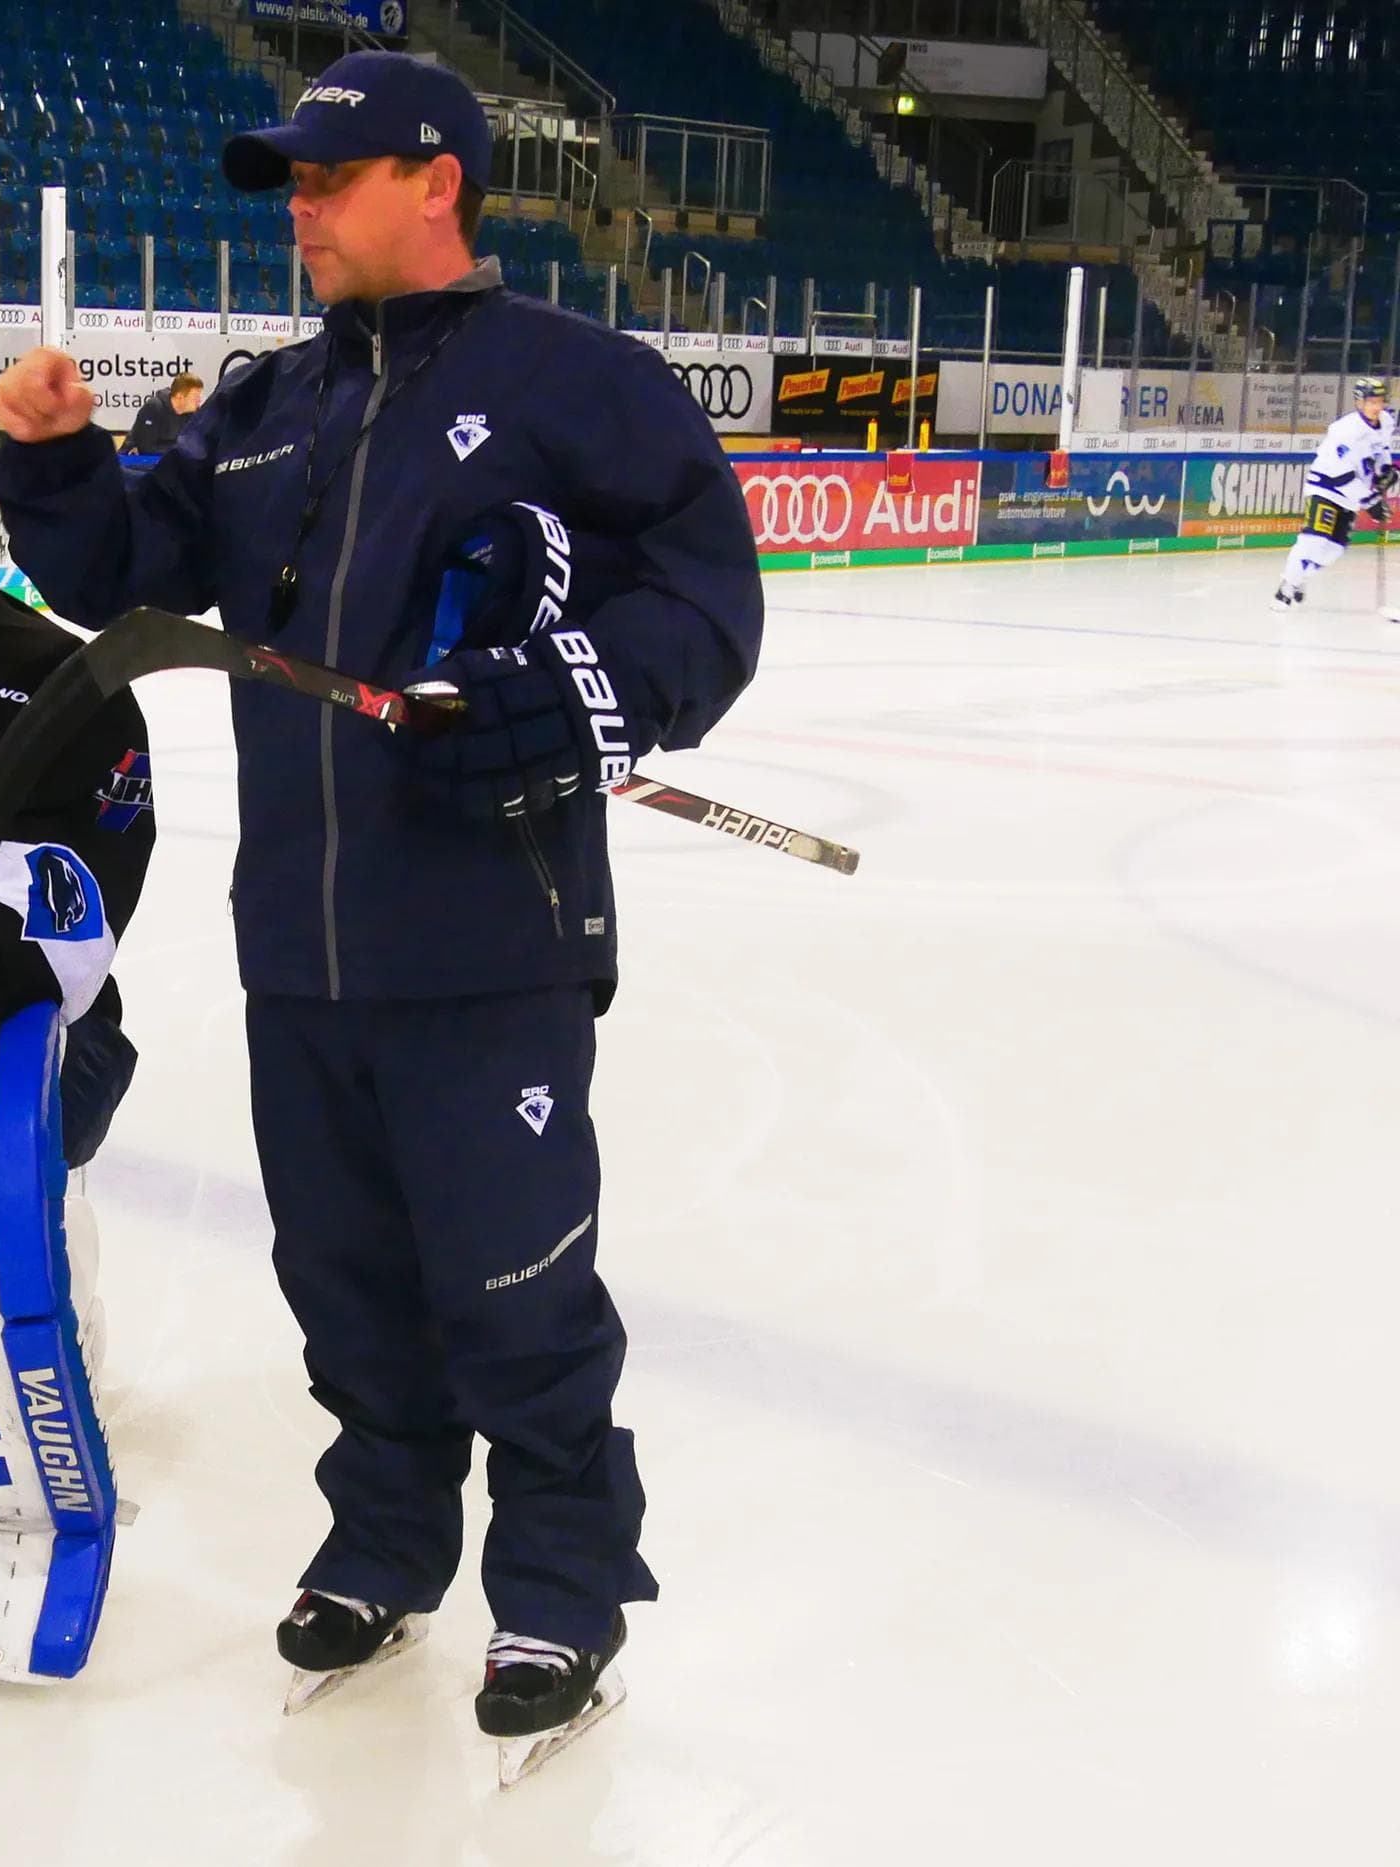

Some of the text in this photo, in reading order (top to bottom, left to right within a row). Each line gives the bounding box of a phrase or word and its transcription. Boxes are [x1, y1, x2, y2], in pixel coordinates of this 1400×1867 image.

[113, 316, 145, 328] Audi
[187, 319, 217, 330] Audi
[262, 321, 291, 333] Audi
[456, 414, 487, 424] ERC
[229, 444, 295, 472] BAUER
[863, 479, 976, 535] Audi
[521, 1085, 549, 1098] ERC
[485, 1257, 550, 1290] BAUER
[18, 1367, 92, 1513] VAUGHN
